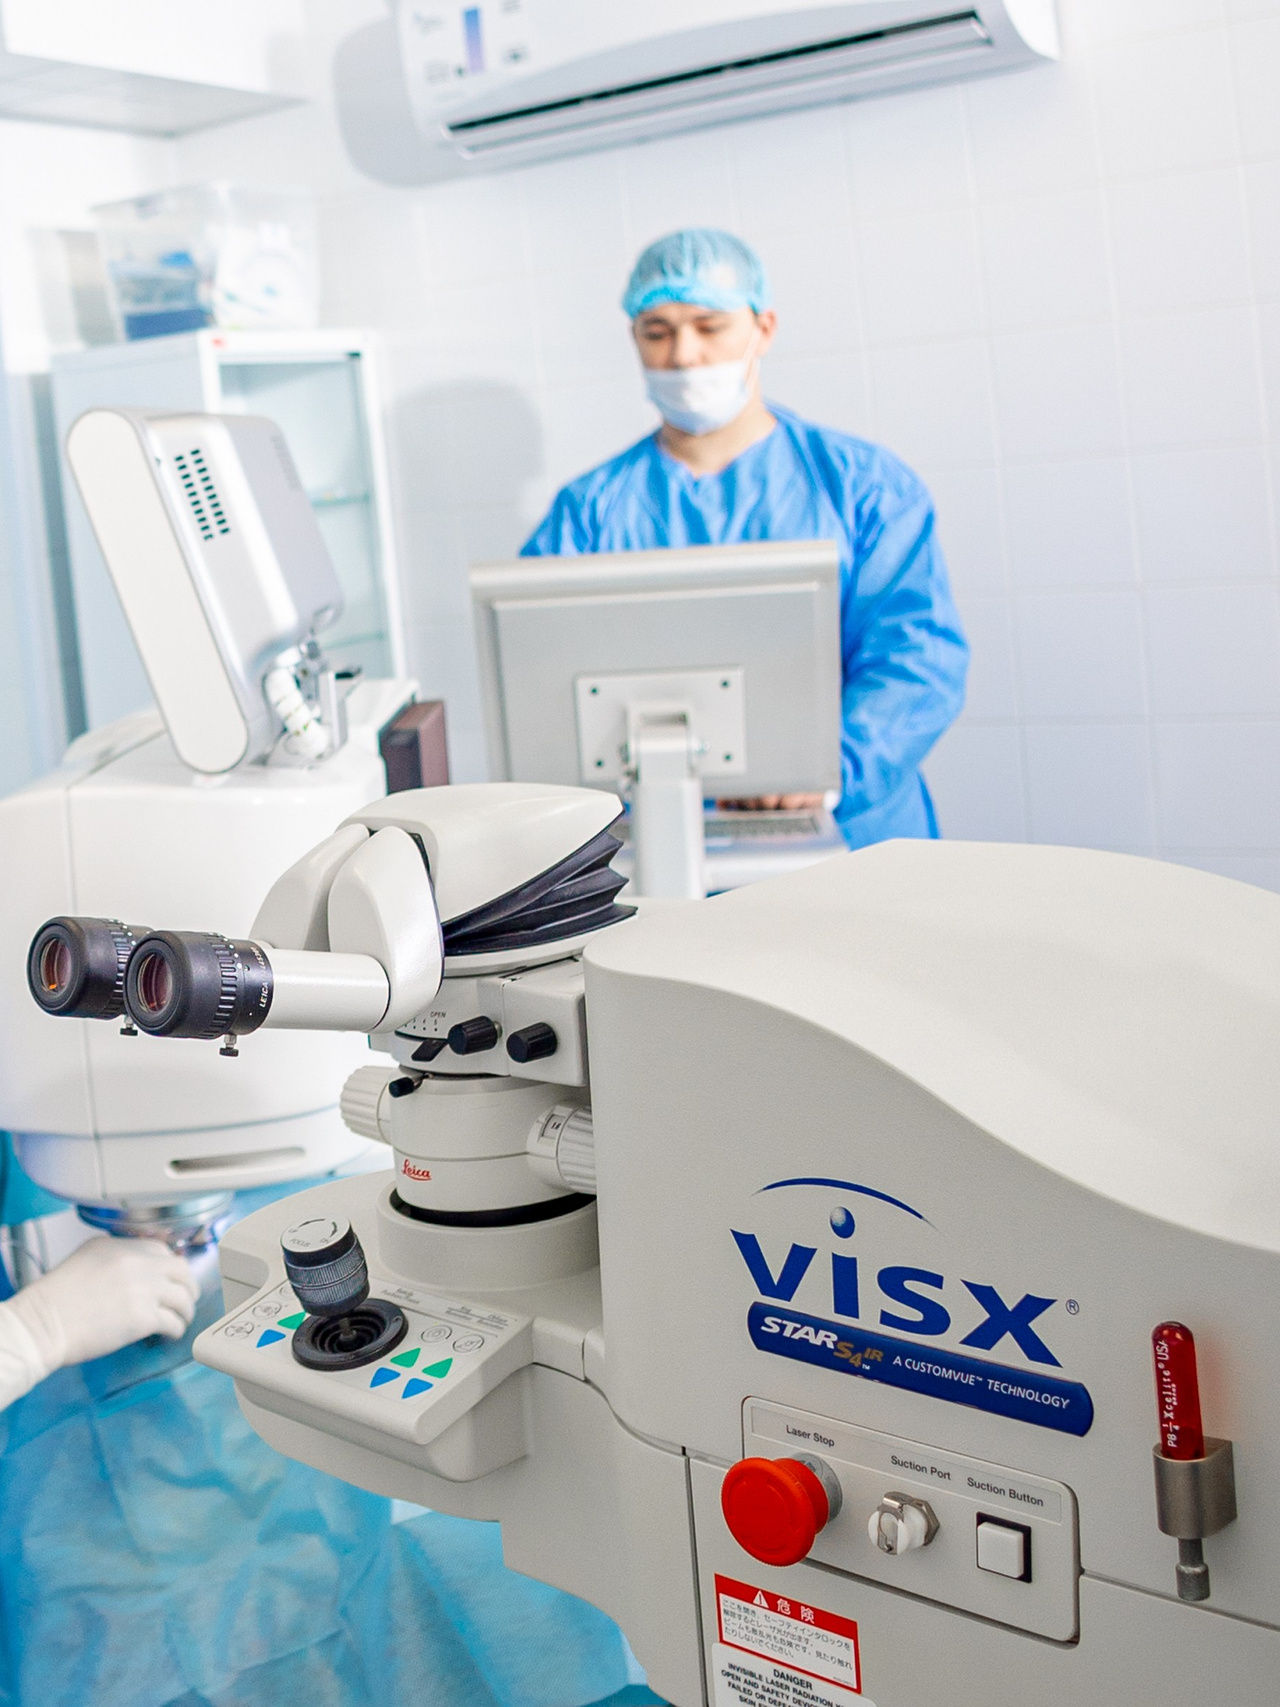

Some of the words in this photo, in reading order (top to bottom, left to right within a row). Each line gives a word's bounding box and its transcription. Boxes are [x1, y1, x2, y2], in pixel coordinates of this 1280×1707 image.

[401, 1159, 432, 1181] Leica
[760, 1316, 838, 1350] STAR
[892, 1355, 902, 1367] A
[987, 1378, 1070, 1409] TECHNOLOGY
[786, 1424, 811, 1440] Laser
[813, 1432, 835, 1447] Stop
[891, 1455, 928, 1474] Suction
[930, 1467, 951, 1481] Port
[967, 1477, 1006, 1496] Suction
[1009, 1489, 1044, 1507] Button
[721, 1669, 741, 1682] OPEN
[744, 1679, 759, 1690] AND
[761, 1685, 789, 1700] SAFETY
[728, 1662, 763, 1681] INVISIBLE
[766, 1676, 790, 1692] LASER
[792, 1687, 833, 1707] RADIATION
[728, 1681, 753, 1696] FAILED
[755, 1692, 766, 1702] OR
[773, 1668, 813, 1690] DANGER
